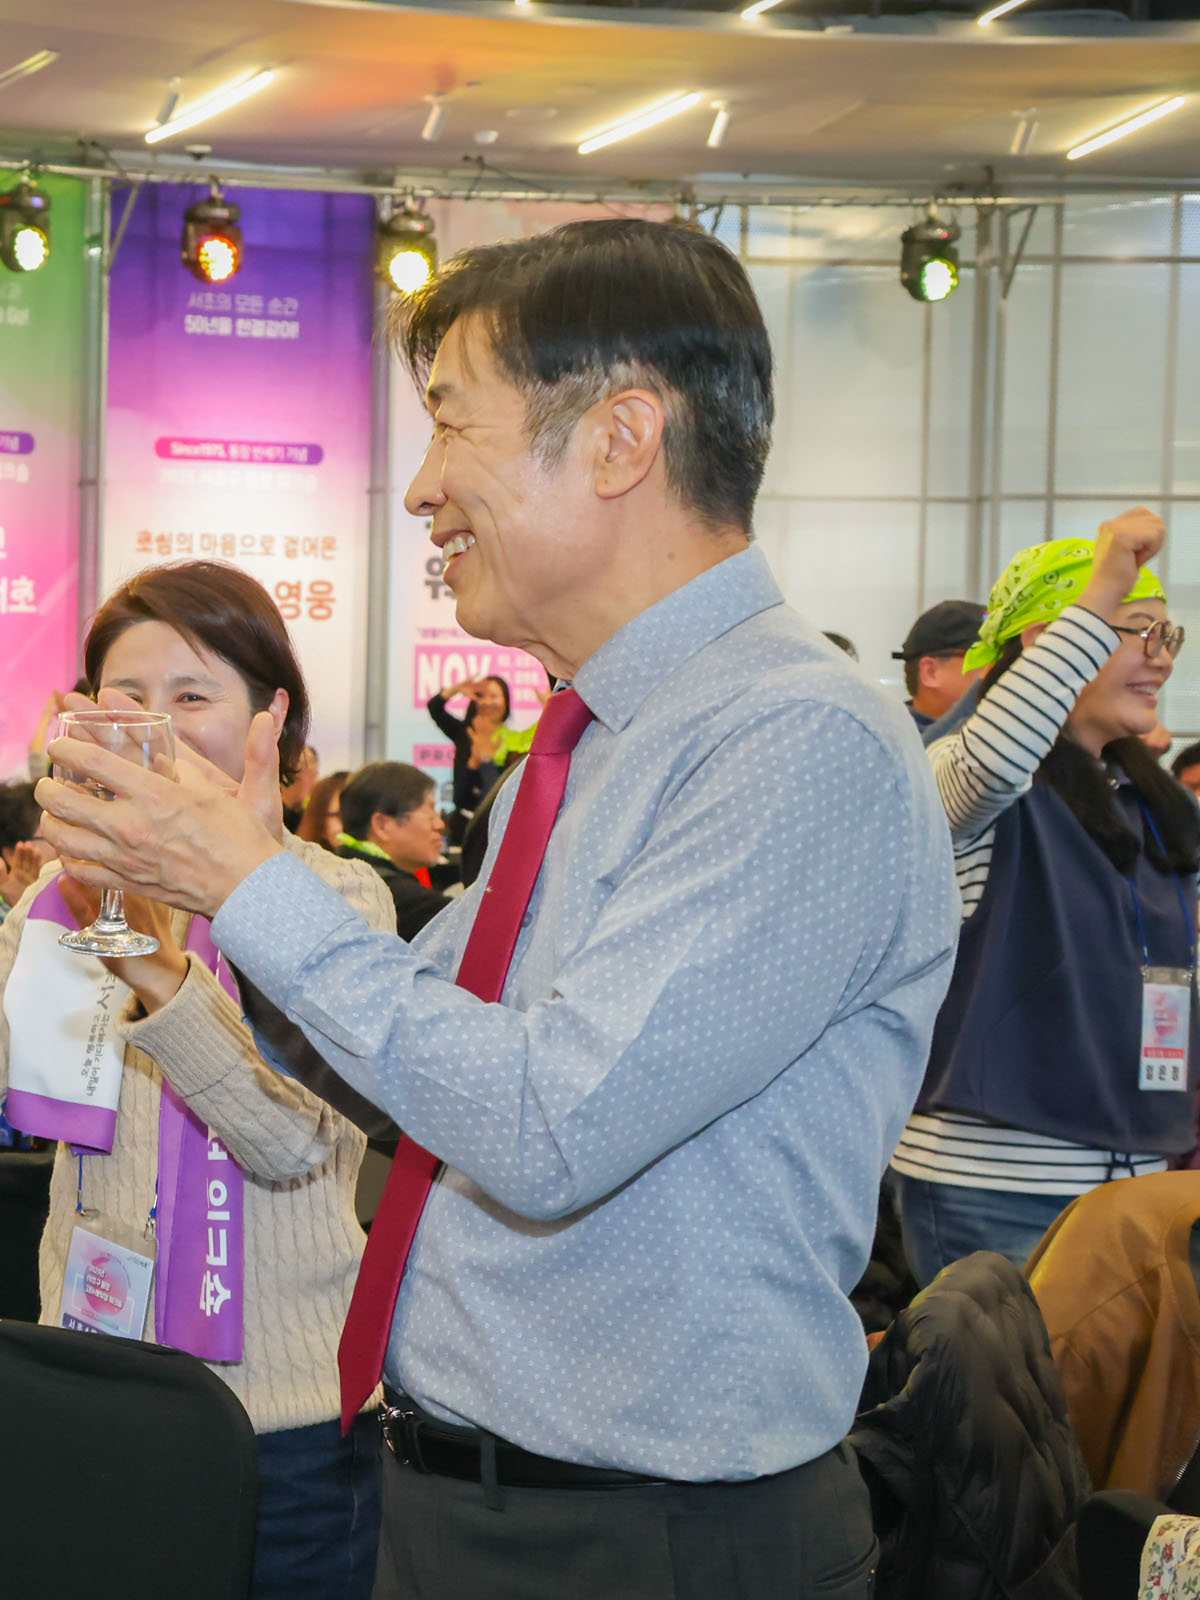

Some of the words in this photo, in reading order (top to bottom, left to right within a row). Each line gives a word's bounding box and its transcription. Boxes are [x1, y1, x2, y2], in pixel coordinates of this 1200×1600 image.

[188, 292, 232, 311] 서초의
[234, 294, 263, 314] 모든
[268, 297, 298, 316] 순간
[135, 529, 193, 555] 초심의
[199, 532, 275, 558] 마음으로
[284, 535, 337, 560] 걸어온
[275, 578, 337, 622] 영웅
[86, 1067, 100, 1097] 내일이
